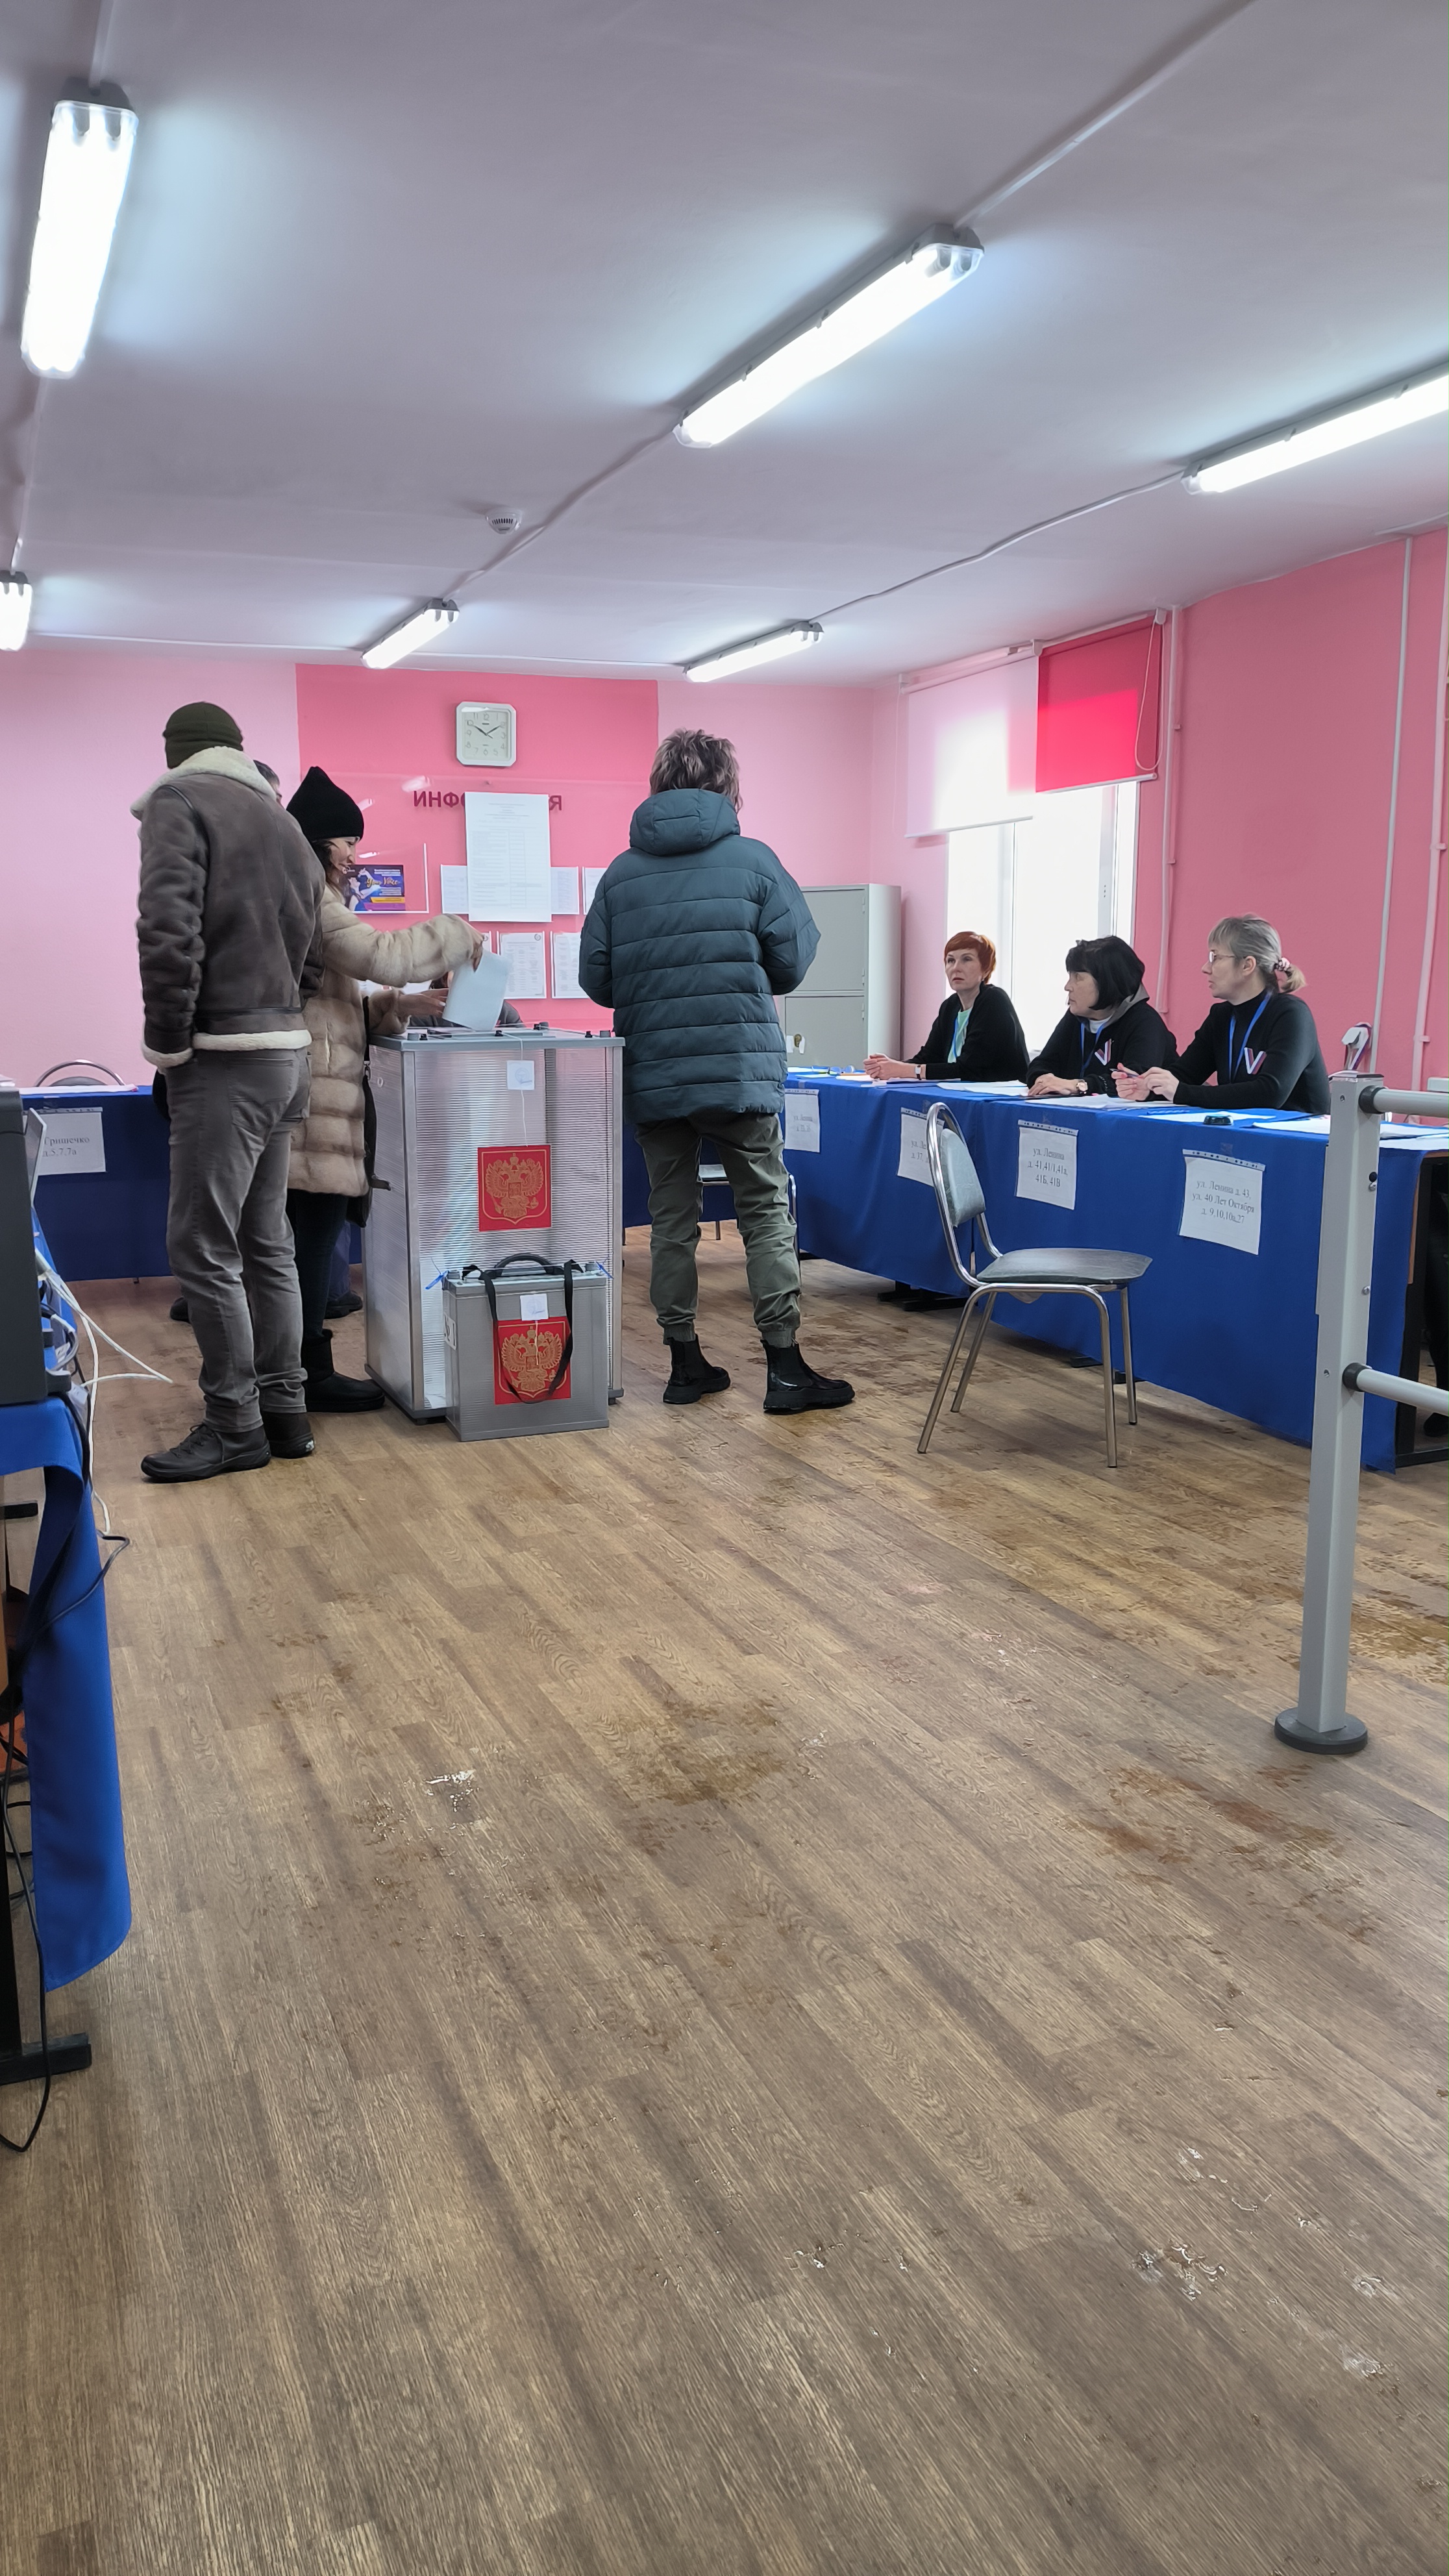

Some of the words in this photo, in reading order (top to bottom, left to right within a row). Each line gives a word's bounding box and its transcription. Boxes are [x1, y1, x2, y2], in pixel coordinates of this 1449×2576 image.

[44, 1137, 90, 1146] Гришечко
[1208, 1181, 1233, 1194] Ленина
[1204, 1193, 1213, 1203] 40
[1214, 1195, 1227, 1206] Лет
[1228, 1198, 1254, 1214] Октября
